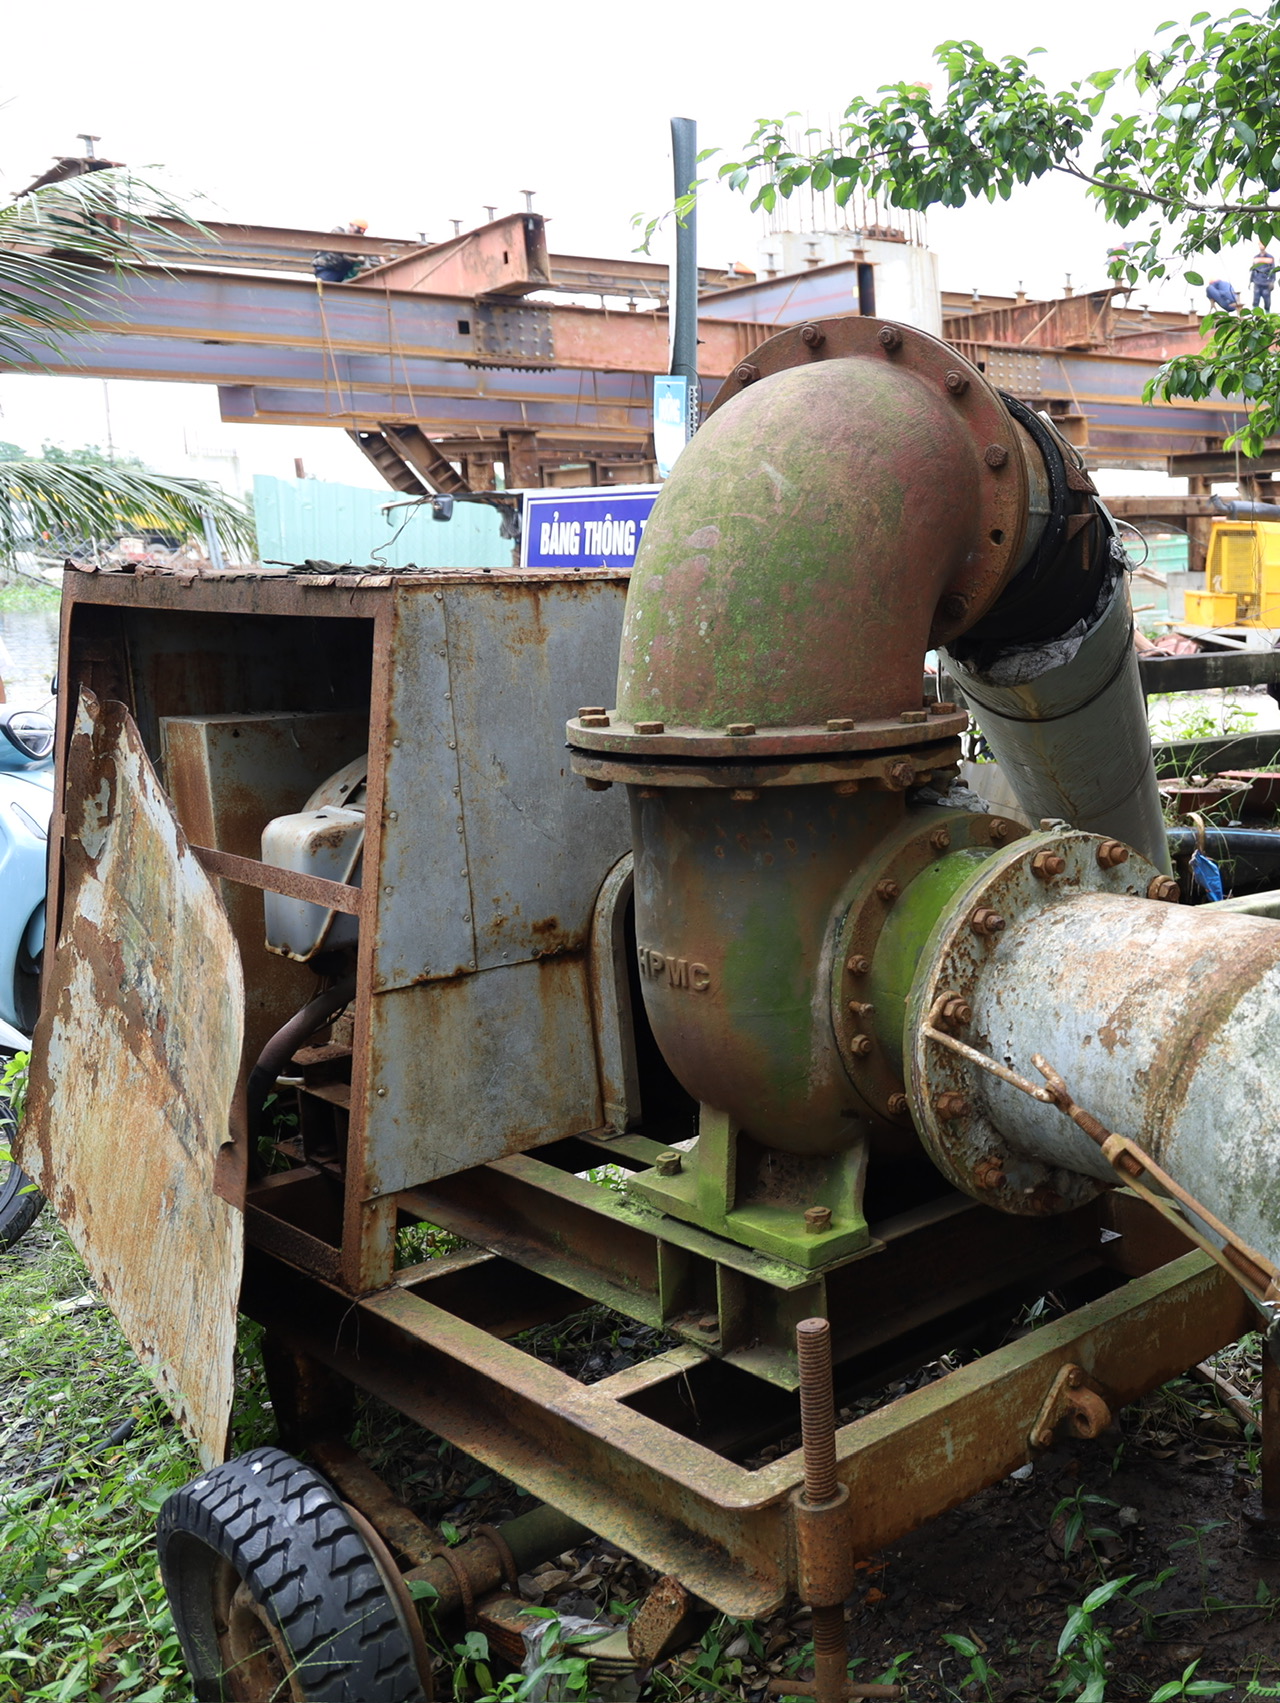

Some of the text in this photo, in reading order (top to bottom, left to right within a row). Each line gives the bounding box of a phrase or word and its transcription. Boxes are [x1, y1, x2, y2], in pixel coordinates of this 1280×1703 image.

[540, 511, 636, 556] BẢNG THÔNG
[638, 945, 710, 992] HPMC
